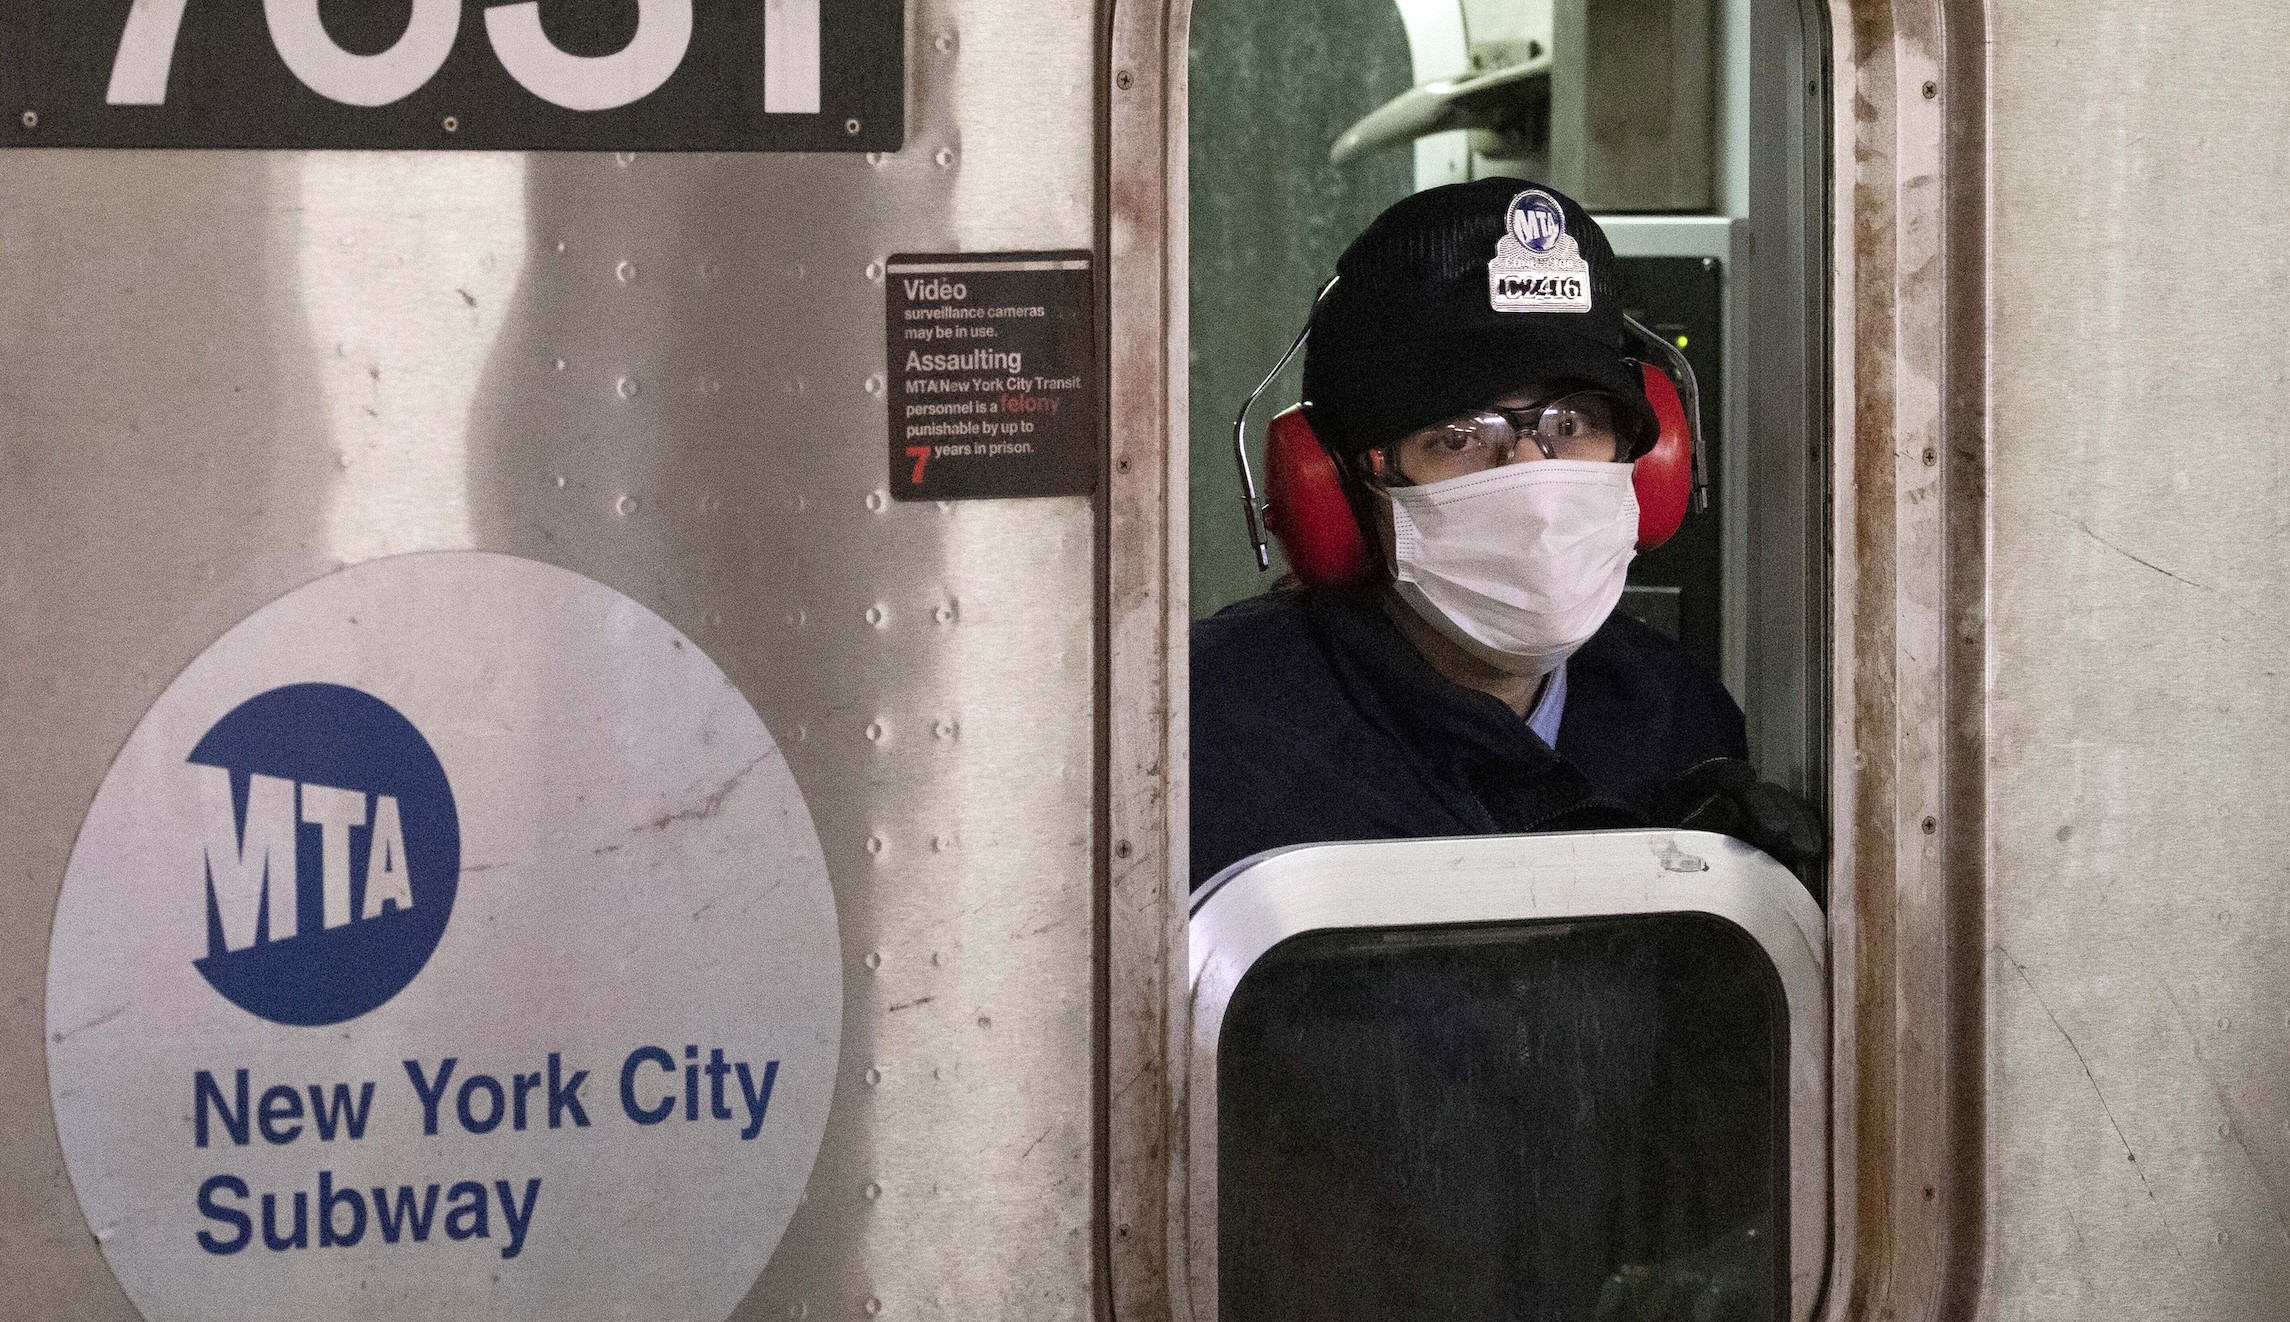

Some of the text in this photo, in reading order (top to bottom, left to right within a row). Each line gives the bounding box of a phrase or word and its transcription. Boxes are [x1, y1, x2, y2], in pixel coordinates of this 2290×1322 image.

[1513, 208, 1559, 242] MTA
[904, 279, 967, 300] Video
[904, 306, 1045, 320] surveillance cameras
[905, 326, 998, 341] may be in use.
[905, 350, 1021, 374] Assaulting
[906, 376, 1081, 393] MTA New York City Transit
[906, 395, 1060, 418] personnel is a felony
[906, 420, 1034, 439] punishable by up to
[906, 441, 1034, 484] 7 years in prison.
[190, 762, 413, 958] MTA
[194, 1044, 780, 1148] New York City
[195, 1170, 542, 1260] Subway
